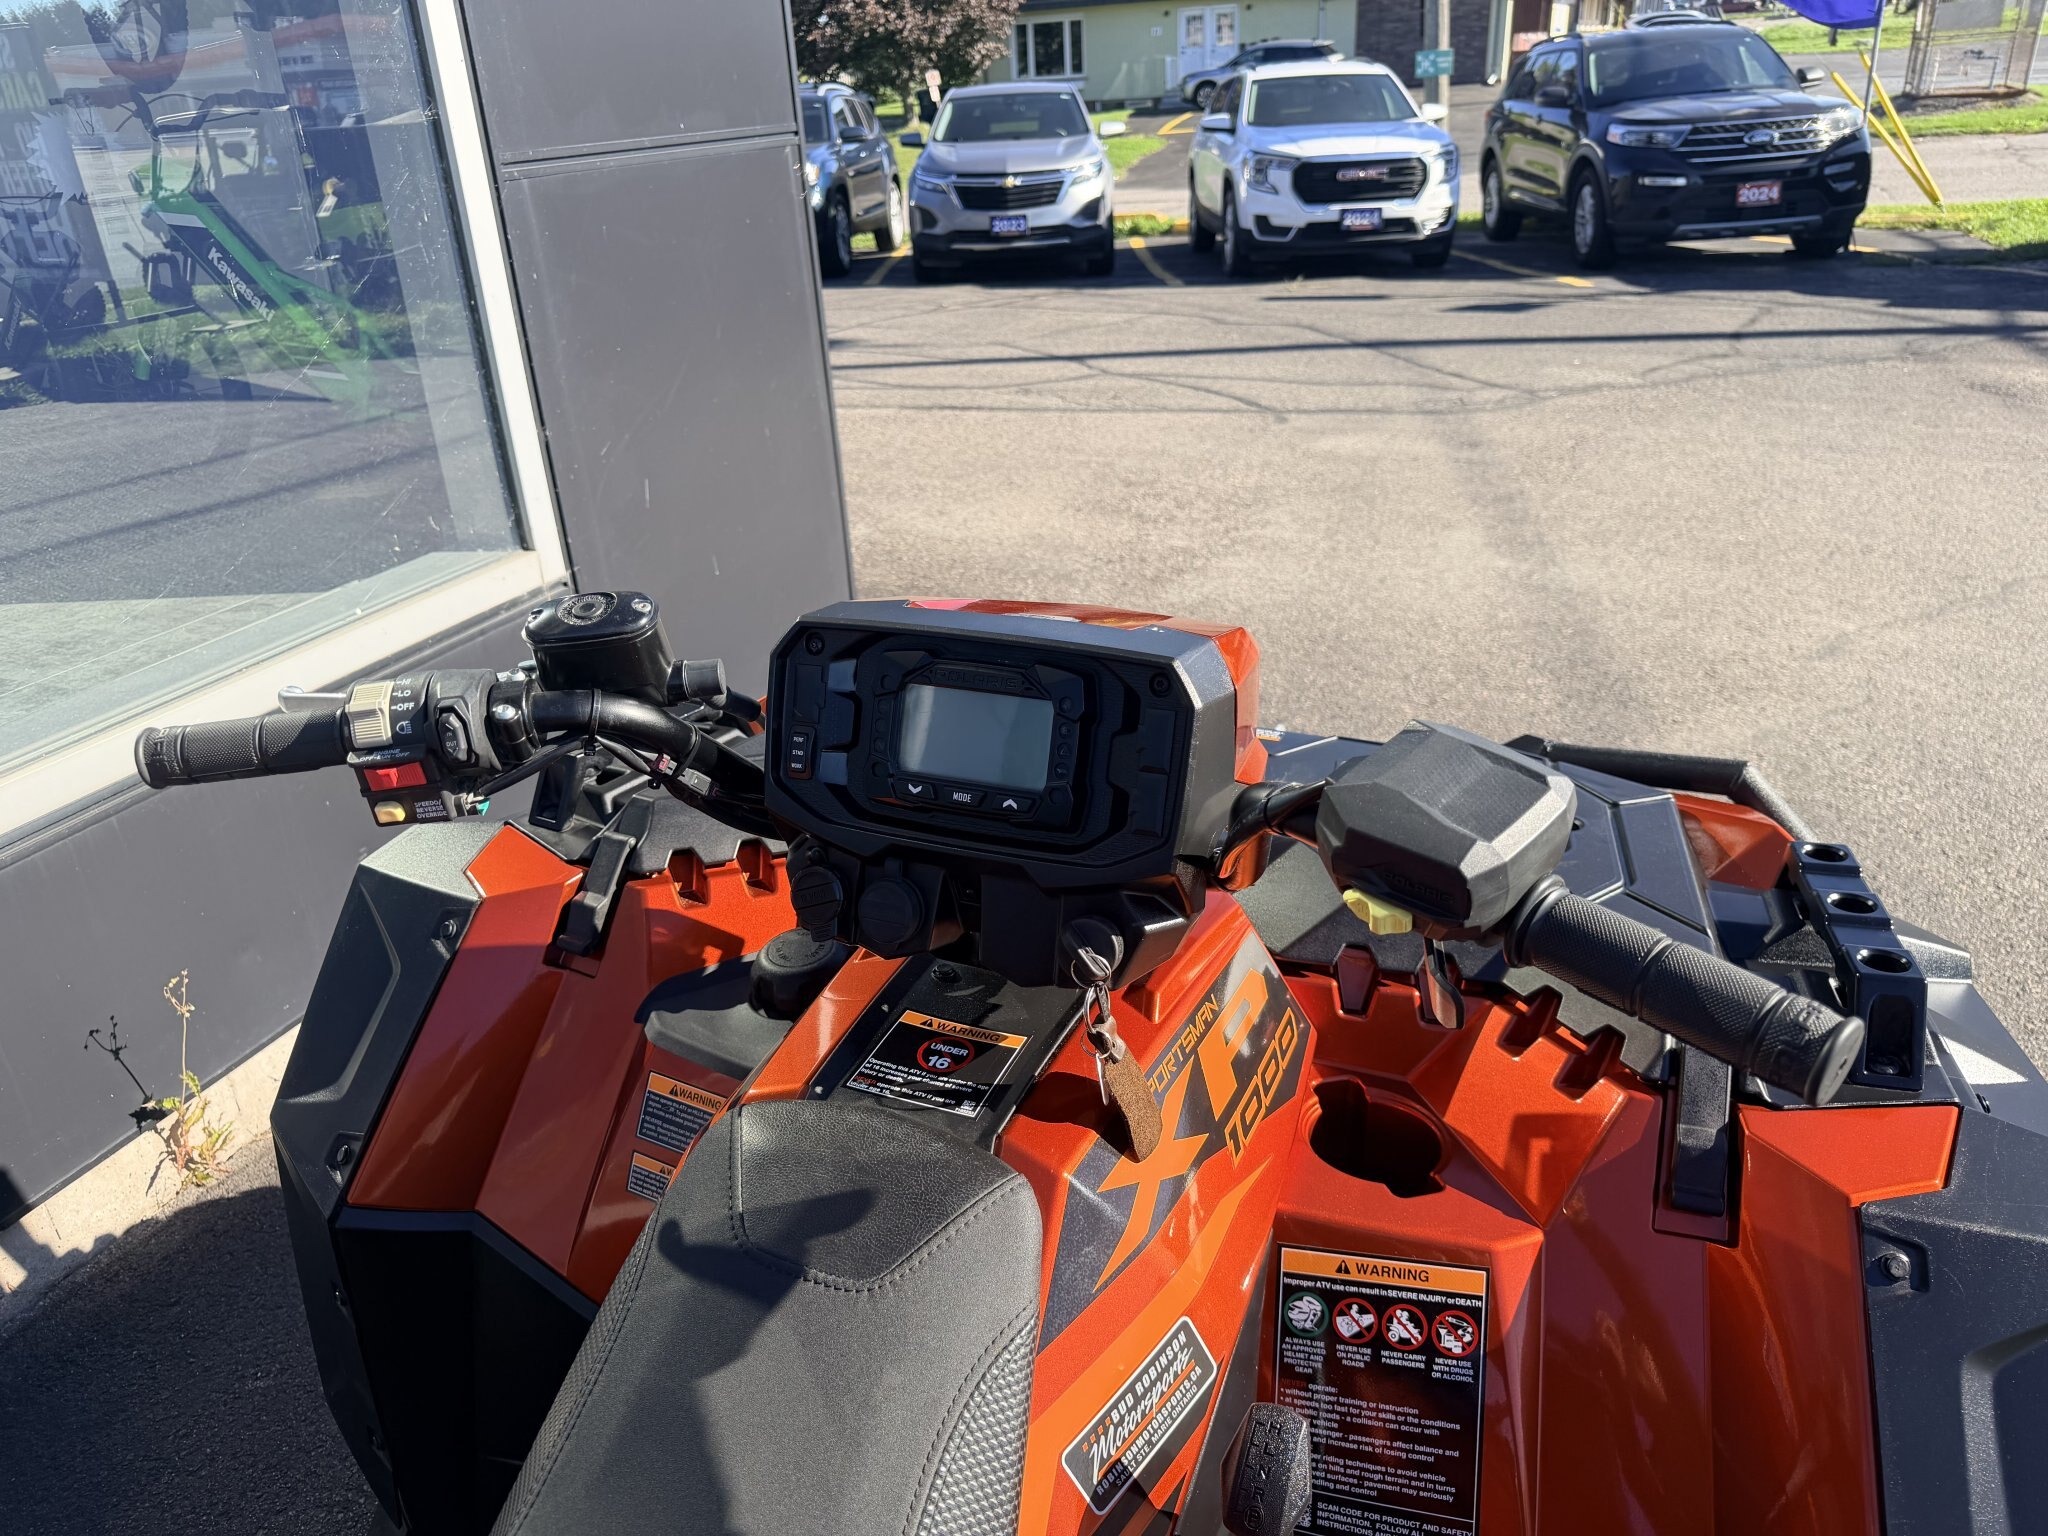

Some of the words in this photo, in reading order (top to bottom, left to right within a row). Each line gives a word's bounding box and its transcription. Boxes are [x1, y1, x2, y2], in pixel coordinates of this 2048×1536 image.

[1738, 186, 1778, 202] 2024
[207, 246, 276, 322] Kawasaki
[396, 702, 415, 710] OFF
[952, 791, 972, 803] MODE
[937, 1022, 1000, 1042] WARNING
[930, 1042, 969, 1057] UNDER
[1148, 993, 1220, 1093] PORTSMAN
[869, 1058, 897, 1069] Operating
[898, 1064, 909, 1072] this
[928, 1055, 952, 1069] 16
[1224, 1006, 1298, 1170] 1000
[679, 1086, 722, 1110] WARNING
[1355, 1263, 1429, 1283] WARNING
[1284, 1277, 1315, 1288] Improper
[1359, 1288, 1380, 1296] result
[1388, 1290, 1418, 1300] SEVERE
[1418, 1294, 1446, 1303] INJURY
[1456, 1298, 1482, 1308] DEATH
[1285, 1337, 1311, 1345] ALWAYS
[1312, 1340, 1325, 1348] USE
[1292, 1345, 1326, 1354] APPROVED
[1336, 1344, 1358, 1352] NEVER
[1284, 1350, 1309, 1360] HELMET
[1310, 1354, 1324, 1362] AND
[1284, 1357, 1322, 1368] PROTECTIVE
[1342, 1359, 1364, 1368] ROADS
[1348, 1352, 1370, 1361] PUBLIC
[1381, 1350, 1402, 1358] NEVER
[1404, 1353, 1426, 1361] CARRY
[1382, 1358, 1425, 1368] PASSENGERS
[1434, 1358, 1457, 1366] NEVER
[1458, 1360, 1472, 1368] USE
[1111, 1392, 1134, 1424] BUD
[1135, 1330, 1187, 1394] ROBINSON
[1294, 1366, 1312, 1374] GEAR
[1432, 1364, 1449, 1372] WITH
[1450, 1366, 1474, 1375] DRUGS
[1442, 1374, 1474, 1383] ALCOHOL
[1308, 1384, 1338, 1393] operate:
[1285, 1388, 1312, 1398] without
[1313, 1393, 1338, 1402] proper
[1339, 1396, 1368, 1408] training
[1378, 1402, 1418, 1414] instruction
[1089, 1346, 1194, 1485] Motorsports
[1294, 1398, 1319, 1408] speeds
[1320, 1402, 1333, 1410] too
[1334, 1404, 1348, 1412] fast
[1361, 1410, 1377, 1418] your
[1378, 1412, 1396, 1420] skills
[1406, 1416, 1419, 1424] the
[1420, 1419, 1460, 1430] conditions
[1096, 1365, 1203, 1496] ROBINSONMOTORSPORTS.CA
[1312, 1419, 1338, 1428] vehicle
[1320, 1411, 1340, 1420] roads
[1352, 1417, 1384, 1428] collision
[1385, 1422, 1398, 1430] can
[1400, 1424, 1422, 1433] occur
[1424, 1427, 1440, 1436] with
[1115, 1462, 1136, 1487] SAULT
[1136, 1444, 1152, 1464] STE.
[1152, 1417, 1173, 1442] MARIE
[1172, 1384, 1198, 1417] ONTARIO
[1312, 1436, 1326, 1444] and
[1328, 1438, 1358, 1450] increase
[1360, 1444, 1374, 1452] risk
[1384, 1449, 1406, 1459] losing
[1408, 1452, 1434, 1462] control
[1348, 1434, 1391, 1446] passengers
[1392, 1441, 1413, 1450] affect
[1414, 1444, 1444, 1455] balance
[1322, 1455, 1344, 1464] riding
[1346, 1459, 1386, 1472] techniques
[1387, 1466, 1396, 1474] to
[1396, 1468, 1418, 1477] avoid
[1419, 1472, 1446, 1482] vehicle
[1328, 1463, 1344, 1473] hills
[1346, 1467, 1360, 1476] and
[1361, 1470, 1384, 1480] rough
[1385, 1474, 1409, 1484] terrain
[1410, 1480, 1425, 1488] and
[1436, 1484, 1456, 1492] turns
[1326, 1474, 1358, 1484] surfaces
[1364, 1480, 1400, 1493] pavement
[1402, 1488, 1418, 1496] may
[1419, 1490, 1454, 1502] seriously
[1336, 1482, 1350, 1490] and
[1351, 1486, 1377, 1496] control
[1316, 1510, 1372, 1528] INFORMATION.
[1376, 1522, 1410, 1535] FOLLOW
[1316, 1518, 1374, 1536] INSTRUCTIONS
[1317, 1502, 1339, 1512] SCAN
[1340, 1507, 1362, 1518] CODE
[1364, 1512, 1380, 1520] FOR
[1382, 1516, 1420, 1528] PRODUCT
[1422, 1524, 1440, 1532] AND
[1441, 1526, 1472, 1536] SAFETY
